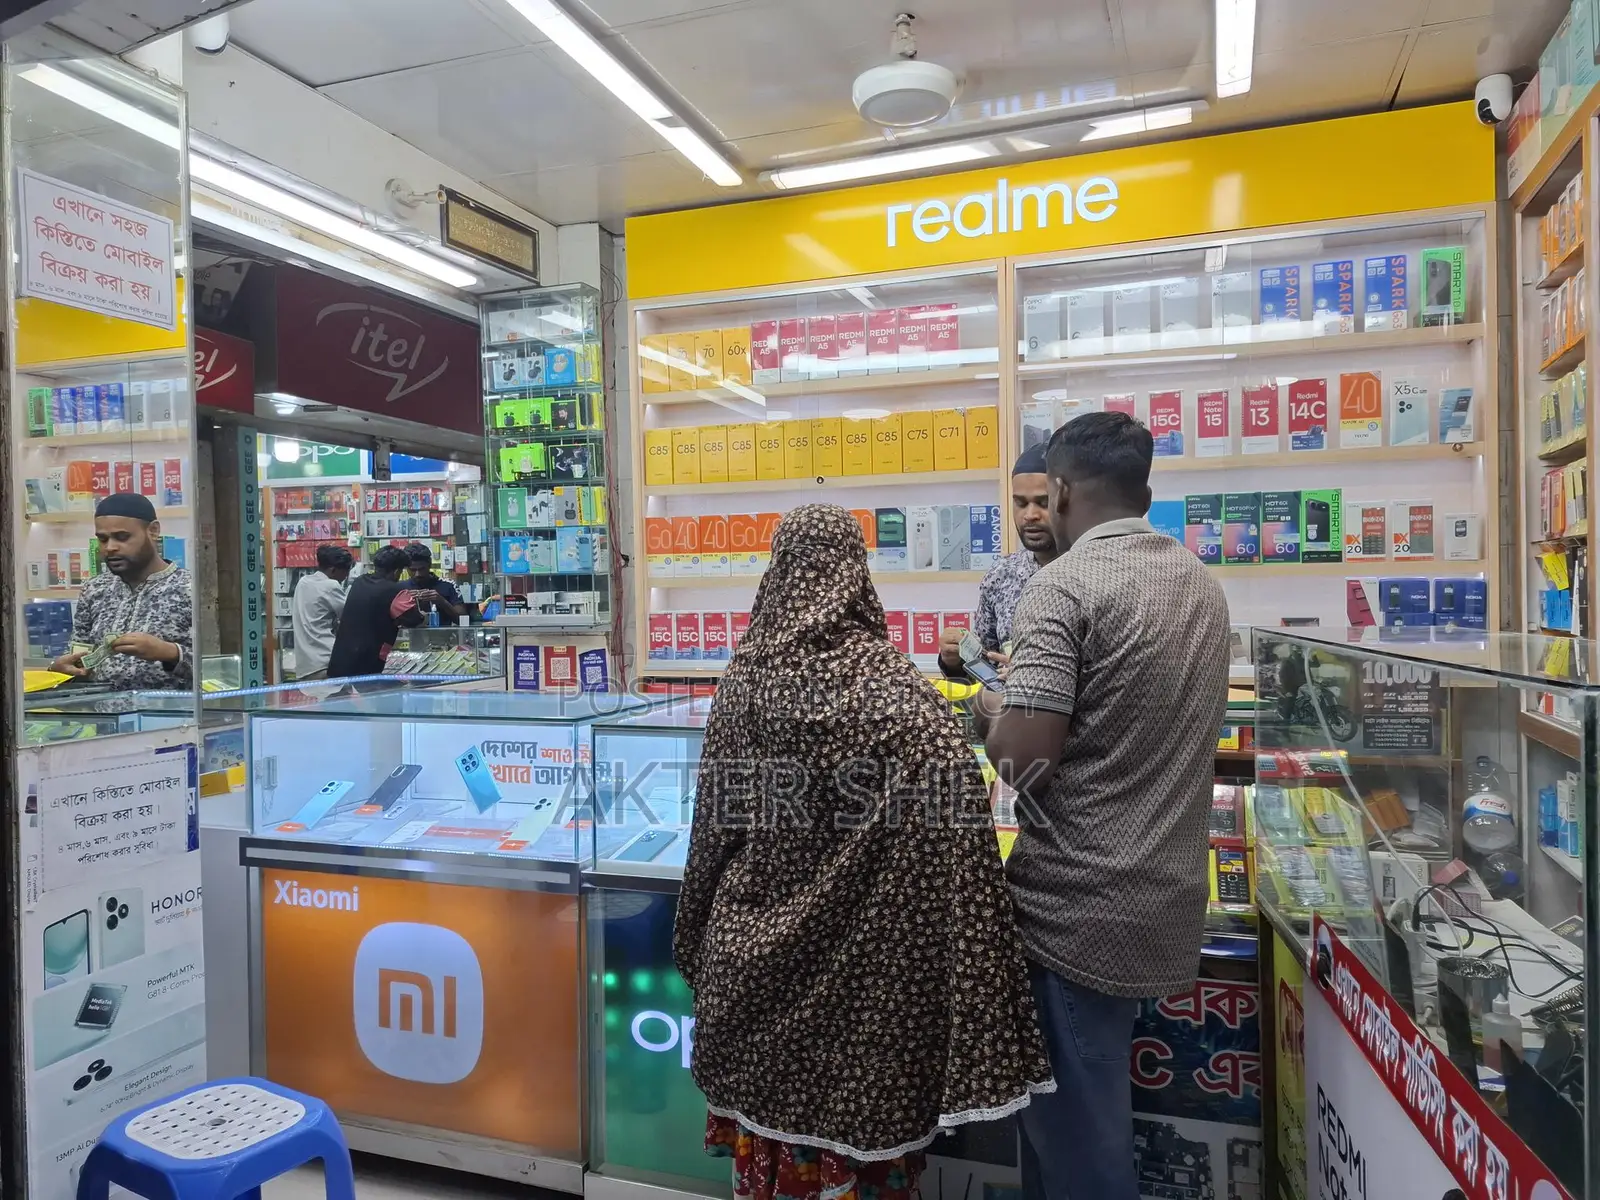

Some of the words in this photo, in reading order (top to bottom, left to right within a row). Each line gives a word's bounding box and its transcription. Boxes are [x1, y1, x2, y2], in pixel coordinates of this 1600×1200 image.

[887, 176, 1119, 247] realme
[53, 196, 105, 226] এখানে
[110, 212, 148, 240] সহজ
[33, 215, 97, 252] কিস্তিতে
[104, 242, 164, 275] মোবাইল
[39, 250, 90, 284] বিক্রয়
[93, 270, 123, 295] করা
[129, 280, 153, 303] হয়
[1453, 252, 1462, 294] SMART
[1338, 262, 1352, 313] SPARK
[1391, 257, 1405, 309] SPARK
[1285, 267, 1298, 318] SPARK
[869, 328, 896, 337] REDMI
[899, 324, 926, 334] REDMI
[930, 322, 957, 331] REDMI
[781, 336, 806, 346] REDMI
[810, 334, 836, 343] REDMI
[838, 331, 865, 340] REDMI
[877, 336, 889, 345] A5
[907, 333, 919, 342] A5
[937, 331, 950, 339] A5
[351, 316, 426, 371] itel
[846, 340, 857, 348] A5
[1028, 335, 1039, 350] 6
[703, 347, 715, 359] 70
[727, 345, 747, 356] 60x
[760, 347, 771, 356] A5
[788, 345, 799, 353] A5
[1343, 378, 1378, 414] 40
[1289, 401, 1326, 420] 14C
[1151, 413, 1180, 427] 15C
[1204, 414, 1222, 427] 15
[1249, 407, 1270, 427] 13
[876, 431, 899, 443] C85
[906, 428, 929, 441] C75
[939, 426, 960, 438] C71
[974, 425, 989, 437] 70
[759, 439, 780, 450] C85
[787, 437, 809, 448] C85
[816, 435, 838, 447] C85
[845, 433, 868, 445] C85
[648, 445, 669, 456] C85
[676, 443, 697, 454] C85
[703, 442, 724, 453] C85
[731, 440, 753, 451] C85
[1331, 493, 1340, 535] SMART
[703, 520, 727, 549] 40
[730, 520, 757, 547] Go
[990, 506, 1001, 552] CAMON
[647, 523, 672, 550] Go
[675, 521, 698, 550] 40
[1198, 544, 1217, 555] 60
[1236, 543, 1256, 555] 60
[1275, 543, 1296, 554] 60
[1347, 545, 1362, 554] 20
[1394, 544, 1410, 553] 20
[650, 631, 671, 642] 15C
[677, 631, 699, 642] 15C
[704, 631, 726, 642] 15C
[888, 631, 903, 642] 15
[918, 632, 934, 644] 15
[481, 740, 538, 764] দেশের
[50, 792, 88, 809] এখানে
[93, 784, 134, 802] কিস্তিতে
[139, 777, 181, 794] মোবাইল
[74, 813, 107, 830] বিক্রয়
[112, 807, 133, 822] করা
[137, 803, 154, 818] হয়
[274, 879, 359, 912] Xiaomi
[147, 969, 178, 988] Powerful
[179, 963, 195, 977] MTK
[124, 1074, 151, 1092] Elegant
[150, 1064, 173, 1080] Design
[1360, 992, 1401, 1084] মোবাইল
[1449, 1093, 1481, 1189] করা
[1317, 1081, 1367, 1200] REDMI
[55, 1147, 75, 1163] 13MP
[75, 1142, 85, 1153] AI
